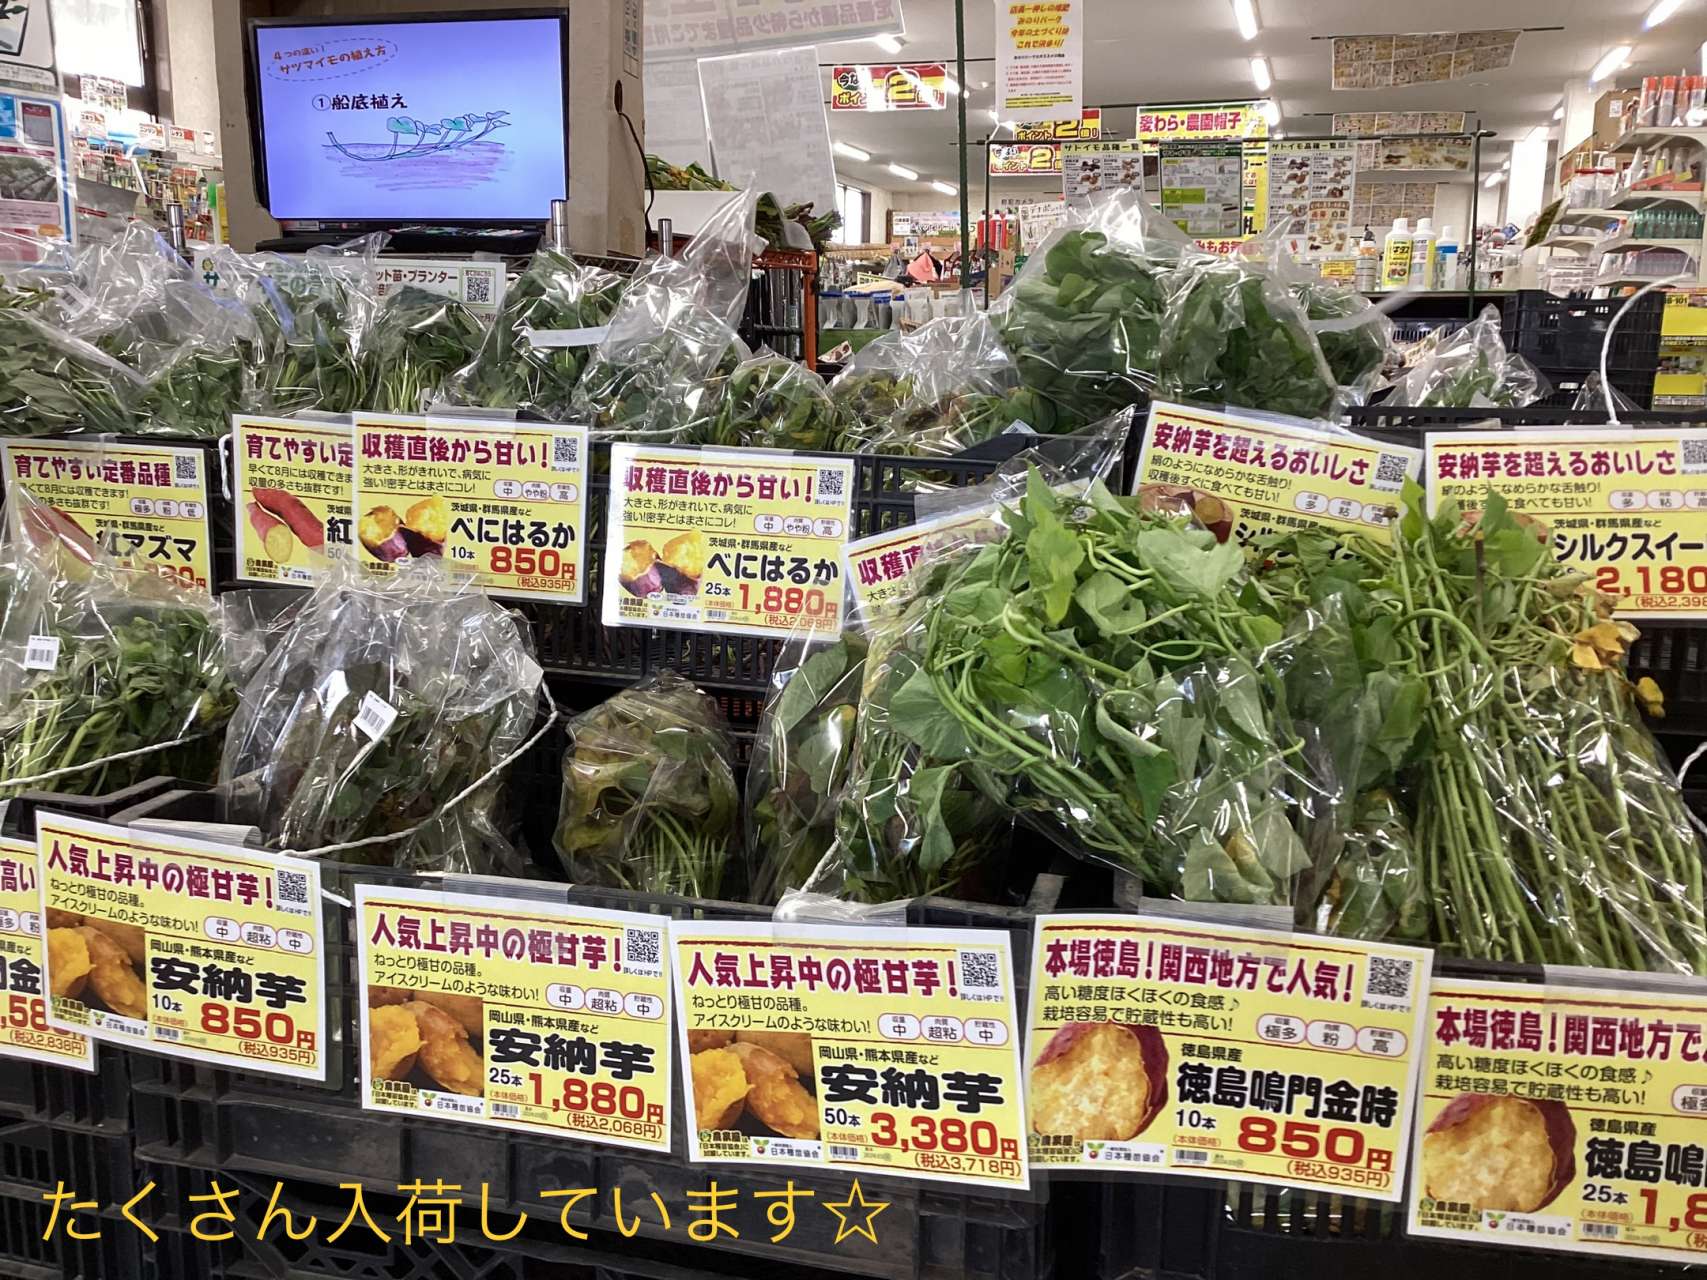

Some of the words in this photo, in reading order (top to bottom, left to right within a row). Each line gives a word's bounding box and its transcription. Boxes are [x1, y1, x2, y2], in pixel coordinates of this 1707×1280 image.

[1029, 145, 1055, 171] 2
[246, 433, 353, 468] 育てやすい定
[361, 432, 549, 469] 収穫直後から甘い!
[1152, 422, 1370, 486] 安納芋を超えるおいしさ
[13, 454, 173, 487] 育てやすい定番品種
[362, 464, 492, 482] 大きさ、形がきれいで、病気に
[1151, 454, 1292, 490] 絹のようになめらかな舌触り!
[1437, 449, 1677, 480] 安納芋を超えるおいしさ
[248, 476, 344, 496] 収量の多さも抜群です!
[503, 488, 513, 496] 中
[559, 491, 568, 500] 高
[623, 465, 814, 503] 収穫直後から甘い!
[1148, 471, 1280, 503] 収穫後すぐに食べても甘い!
[450, 502, 532, 516] 茨城県・群馬県産など
[624, 497, 752, 515] 大きさ、形がきれいで、病気に
[450, 516, 576, 549] べにはるか
[763, 522, 774, 531] 中
[822, 526, 833, 535] 高
[1554, 518, 1662, 528] 茨城県・群馬県産など
[451, 546, 475, 560] 10本
[708, 537, 792, 552] 茨城県・群馬県産など
[489, 545, 576, 580] 850円
[707, 552, 839, 586] べにはるか
[516, 574, 576, 592] (税込935円)
[705, 582, 731, 596] 25本
[1596, 566, 1707, 597] 2,180
[739, 583, 838, 618] 1,880円
[0, 859, 36, 892] 高い
[48, 840, 273, 909] 人気上昇中の極甘芋!
[50, 878, 145, 908] ねっとり極甘の品種。
[50, 894, 198, 933] アイスクリームのような味わい!
[216, 927, 228, 938] 中
[289, 939, 301, 950] 中
[371, 912, 622, 973] 人気上昇中の極甘芋!
[149, 939, 255, 966] 岡山県・熊本県産など
[373, 954, 483, 977] ねっとり極甘の品種。
[688, 951, 957, 998] 人気上昇中の極甘芋!
[1044, 938, 1355, 1003] 本場徳島!関西地方で人気!
[150, 957, 308, 1010] 安納芋
[374, 971, 539, 1002] アイスクリームのような味わい!
[152, 993, 183, 1013] 10本
[559, 994, 572, 1006] 中
[591, 998, 617, 1012] 超粘
[636, 1004, 650, 1015] 中
[692, 995, 808, 1013] ねっとり極甘の品種。
[200, 1002, 315, 1051] 850円
[489, 1009, 600, 1034] 岡山県・熊本県産など
[693, 1014, 871, 1034] アイスクリームのような味わい!
[892, 1024, 907, 1036] 中
[1043, 1006, 1233, 1031] 栽培容易で貯蔵性も高い!
[10, 1032, 86, 1056] (税込2,838円)
[928, 1026, 957, 1040] 超粘
[978, 1030, 993, 1042] 中
[1264, 1025, 1297, 1040] 極多
[1323, 1032, 1340, 1047] 粉
[1436, 1006, 1707, 1062] 本場徳島!関西地方で
[238, 1041, 316, 1066] (税込935円)
[489, 1028, 655, 1080] 安納芋
[818, 1045, 939, 1066] 岡山県・熊本県産など
[1181, 1042, 1243, 1063] 徳島県産
[1372, 1038, 1389, 1053] 高
[489, 1067, 523, 1087] 25本
[820, 1064, 1005, 1114] 安納芋
[1435, 1074, 1646, 1105] 栽培容易で貯蔵性も高い!
[528, 1072, 664, 1125] 1,880円
[1177, 1062, 1398, 1129] 徳島鳴門金時
[566, 1113, 663, 1140] (税込2,068円)
[824, 1108, 861, 1127] 50本
[1176, 1109, 1217, 1130] 10本
[1590, 1118, 1657, 1137] 徳島県産
[871, 1112, 1022, 1162] 3,380円
[1237, 1115, 1393, 1172] 850円
[914, 1152, 1023, 1178] (税込3,718円)
[1286, 1160, 1391, 1188] (税込935円)
[1585, 1137, 1707, 1188] 徳島鳴
[1582, 1183, 1629, 1206] 25本
